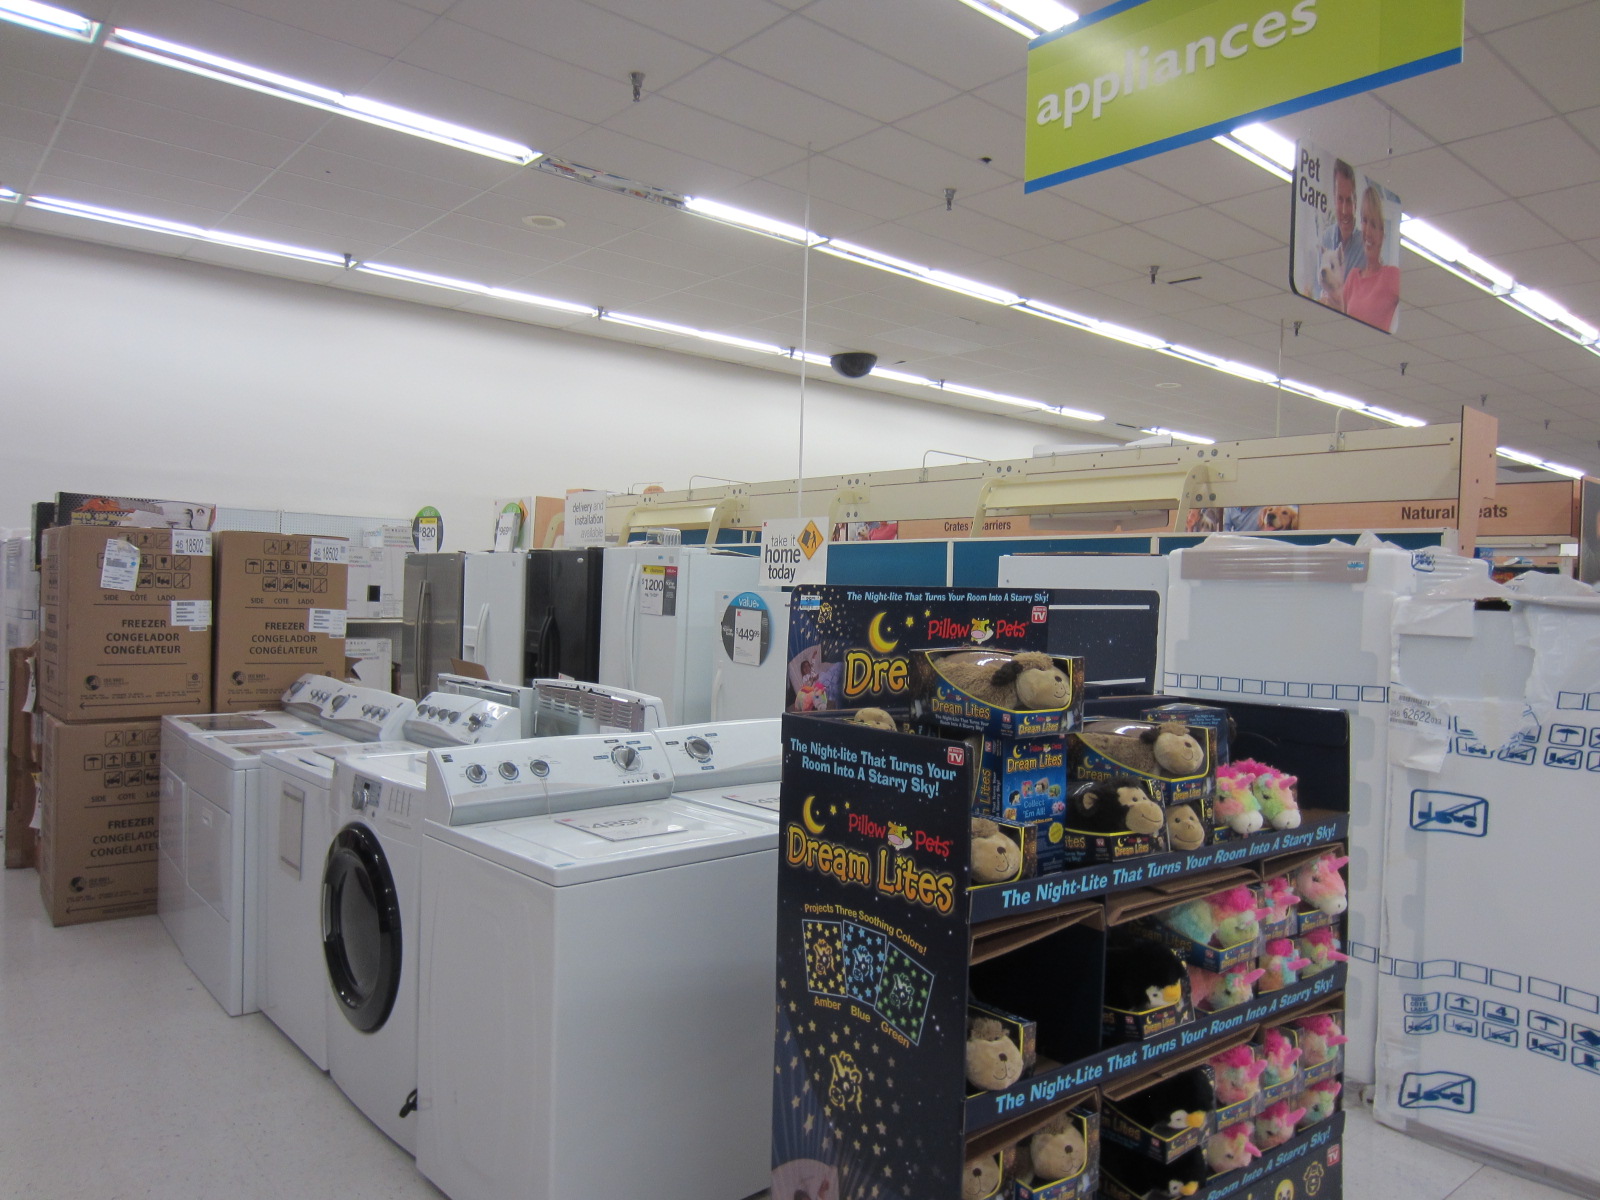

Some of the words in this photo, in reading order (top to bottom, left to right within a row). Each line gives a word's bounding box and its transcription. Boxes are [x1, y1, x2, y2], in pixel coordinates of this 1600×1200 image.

[1036, 0, 1318, 129] appliances
[1300, 147, 1320, 184] Pet
[1299, 174, 1328, 214] Care
[572, 501, 593, 514] delivery
[593, 500, 604, 511] and
[1401, 505, 1455, 520] Natural
[1479, 504, 1508, 518] ats
[574, 513, 604, 526] installation
[944, 521, 969, 532] Crates
[580, 526, 604, 539] available
[771, 534, 788, 547] take
[790, 533, 796, 547] it
[185, 537, 204, 553] 18502
[765, 544, 801, 564] home
[768, 564, 796, 583] today
[641, 578, 664, 591] $1200
[103, 593, 119, 601] SIDE
[250, 597, 265, 605] SIDE
[738, 597, 756, 608] value
[847, 591, 863, 602] The
[864, 591, 903, 603] Night-lite
[905, 592, 923, 602] That
[924, 592, 946, 602] Turns
[948, 593, 966, 602] Your
[966, 593, 987, 602] Room
[988, 593, 1003, 602] Into
[1003, 593, 1009, 602] A
[1010, 593, 1033, 604] Starry
[1034, 593, 1049, 604] Sky!
[122, 619, 167, 628] FREEZER
[1033, 612, 1046, 621] TV
[265, 622, 305, 631] FREEZER
[928, 619, 970, 640] Pillow
[996, 621, 1026, 639] Pets
[106, 632, 180, 642] CONGELADOR
[251, 634, 316, 643] CONGELADOR
[104, 643, 181, 655] CONGÉLATEUR
[249, 645, 318, 655] CONGÉLATEUR
[845, 650, 910, 696] Dre
[932, 698, 963, 715] Dream
[965, 700, 990, 720] Lites
[1402, 707, 1431, 724] 62622
[1018, 723, 1041, 735] Dream
[1042, 721, 1059, 733] Lites
[790, 738, 807, 753] The
[810, 742, 857, 763] Night-lite
[860, 751, 886, 768] That
[889, 756, 923, 775] Turns
[927, 763, 957, 781] Your
[949, 753, 962, 763] TV
[1007, 757, 1037, 774] Dream
[1039, 752, 1063, 768] Lites
[802, 756, 831, 774] Room
[833, 762, 855, 779] Into
[857, 766, 866, 781] A
[868, 767, 908, 793] Starry
[911, 777, 940, 799] Sky!
[1077, 766, 1112, 783] Dream
[979, 768, 992, 804] Lites
[91, 795, 107, 803] SIDE
[1023, 799, 1046, 809] Collect
[108, 816, 155, 829] FREEZER
[92, 830, 159, 845] CONGELADO
[848, 813, 887, 839] Pillow
[915, 830, 951, 858] Pets
[1065, 836, 1086, 848] ites
[90, 842, 159, 858] CONGÉLATEU
[787, 823, 871, 886] Dream
[878, 848, 955, 914] Lites
[1002, 887, 1031, 909] The
[1035, 874, 1108, 904] Night-Lite
[1112, 866, 1143, 886] That
[1147, 860, 1182, 879] Turns
[1185, 854, 1212, 872] Your
[1214, 846, 1247, 864] Room
[1248, 841, 1271, 857] Into
[1272, 837, 1280, 851] A
[1281, 829, 1314, 851] Starry
[1315, 822, 1337, 842] Sky!
[804, 902, 834, 914] Projects
[835, 903, 857, 919] Three
[858, 909, 895, 936] Soothing
[895, 928, 928, 956] Colors!
[813, 996, 842, 1011] Amber
[850, 1004, 871, 1023] Blue
[880, 1020, 911, 1048] Green
[995, 1089, 1025, 1114] The
[1030, 1058, 1103, 1101] Night-Lite
[1107, 1049, 1138, 1073] That
[1141, 1038, 1177, 1060] Turns
[1180, 1025, 1208, 1046] Your
[1210, 1015, 1243, 1035] Room
[1245, 1006, 1268, 1023] Into
[1269, 1001, 1277, 1015] A
[1279, 987, 1312, 1012] Starry
[1313, 975, 1335, 997] Sky!
[1207, 1179, 1239, 1200] Room
[1239, 1168, 1262, 1186] Into
[1264, 1160, 1273, 1172] A
[1275, 1142, 1308, 1168] Starry
[1309, 1125, 1331, 1149] Sky!
